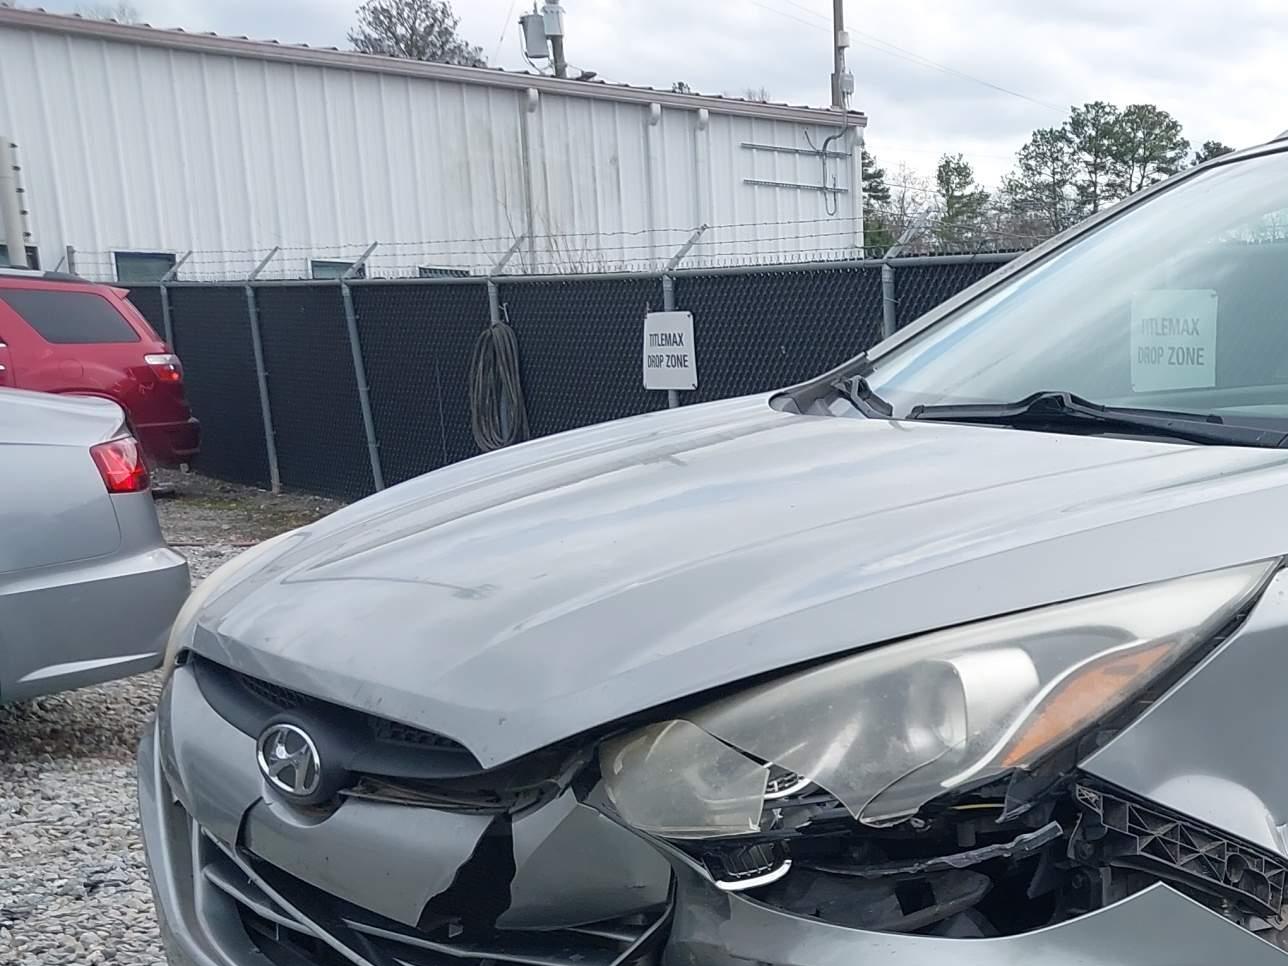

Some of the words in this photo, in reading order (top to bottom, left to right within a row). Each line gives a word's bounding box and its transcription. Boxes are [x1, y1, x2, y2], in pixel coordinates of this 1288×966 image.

[649, 333, 684, 346] TITLEMAX
[647, 354, 664, 368] DROP
[665, 354, 689, 368] ZONE
[1137, 345, 1164, 365] DROP
[1167, 346, 1206, 366] ZONE
